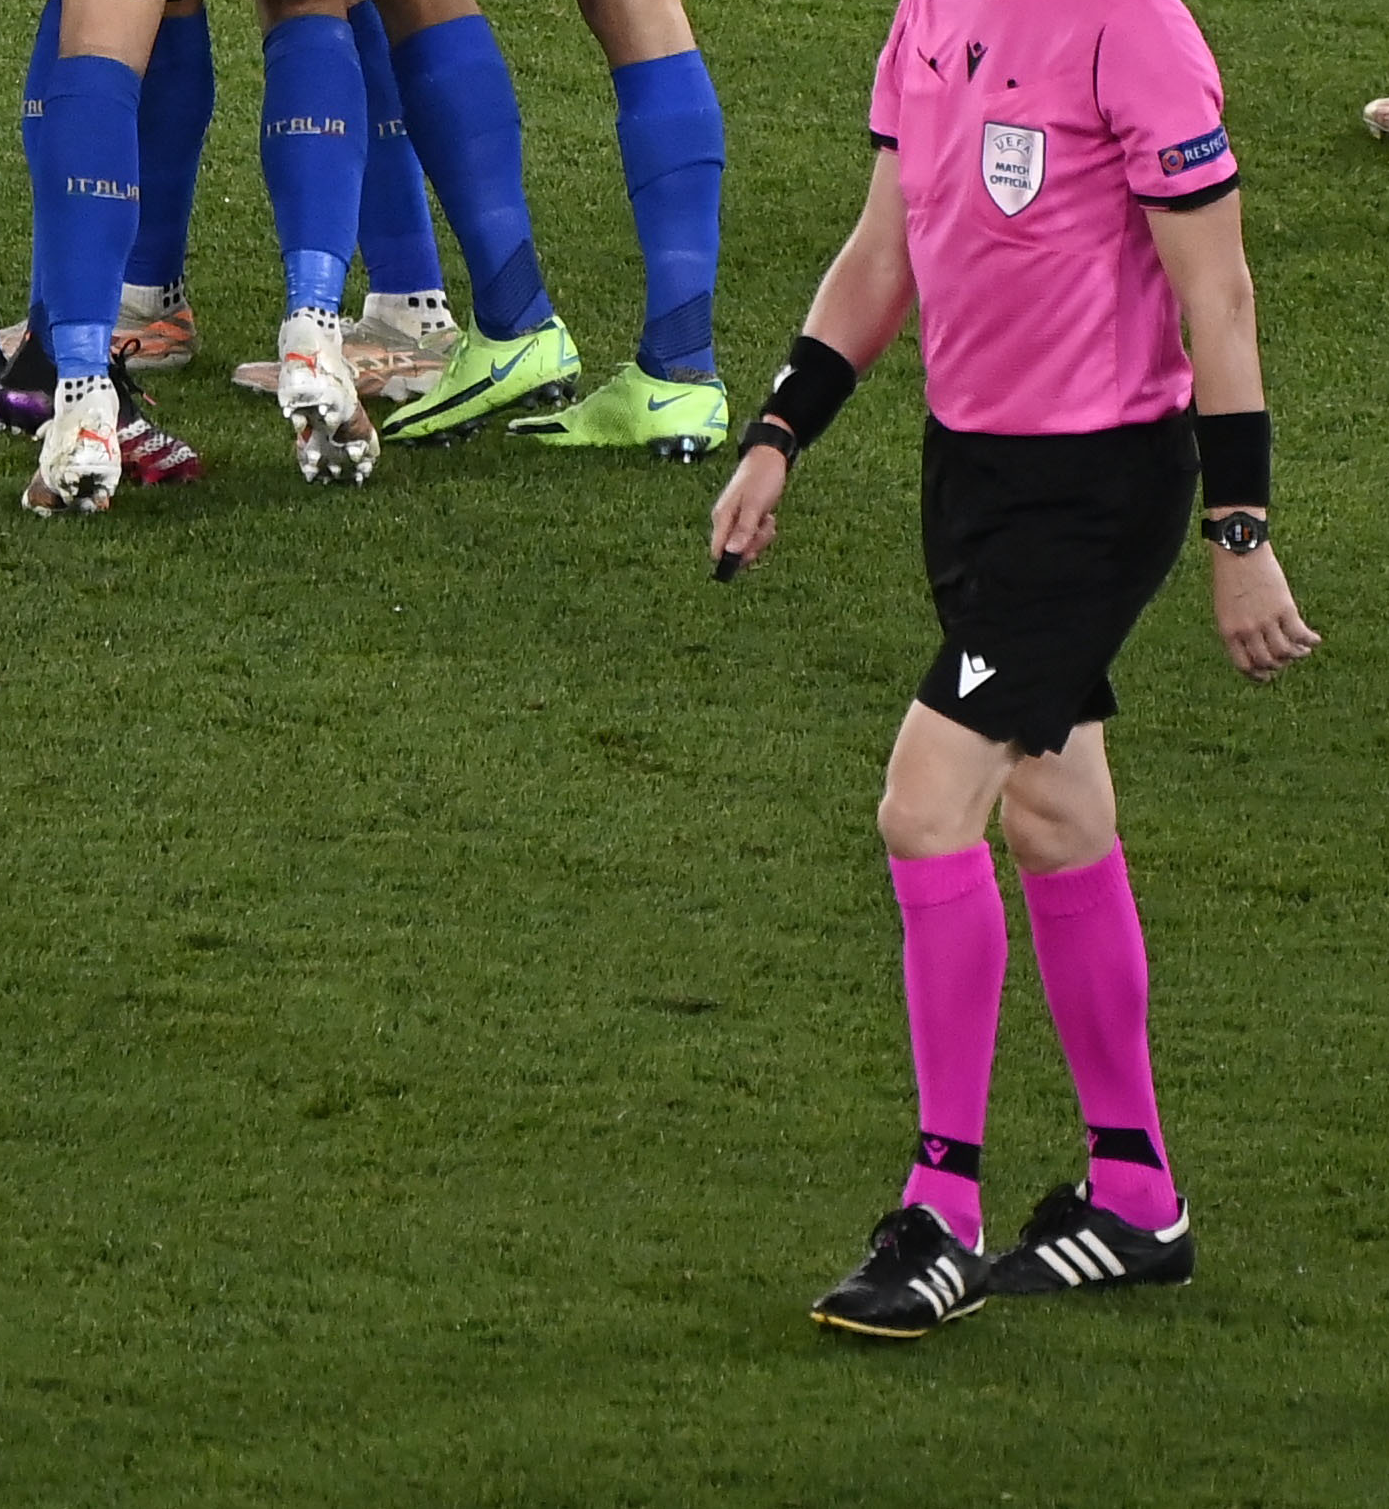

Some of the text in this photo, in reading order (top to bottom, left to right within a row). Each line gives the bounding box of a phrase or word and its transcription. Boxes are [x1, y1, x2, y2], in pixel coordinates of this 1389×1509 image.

[266, 116, 346, 138] ITALIA
[994, 136, 1031, 155] UEFA
[995, 161, 1030, 177] MATCH
[66, 176, 140, 201] ITALIA
[989, 174, 1033, 191] OFFICIAL
